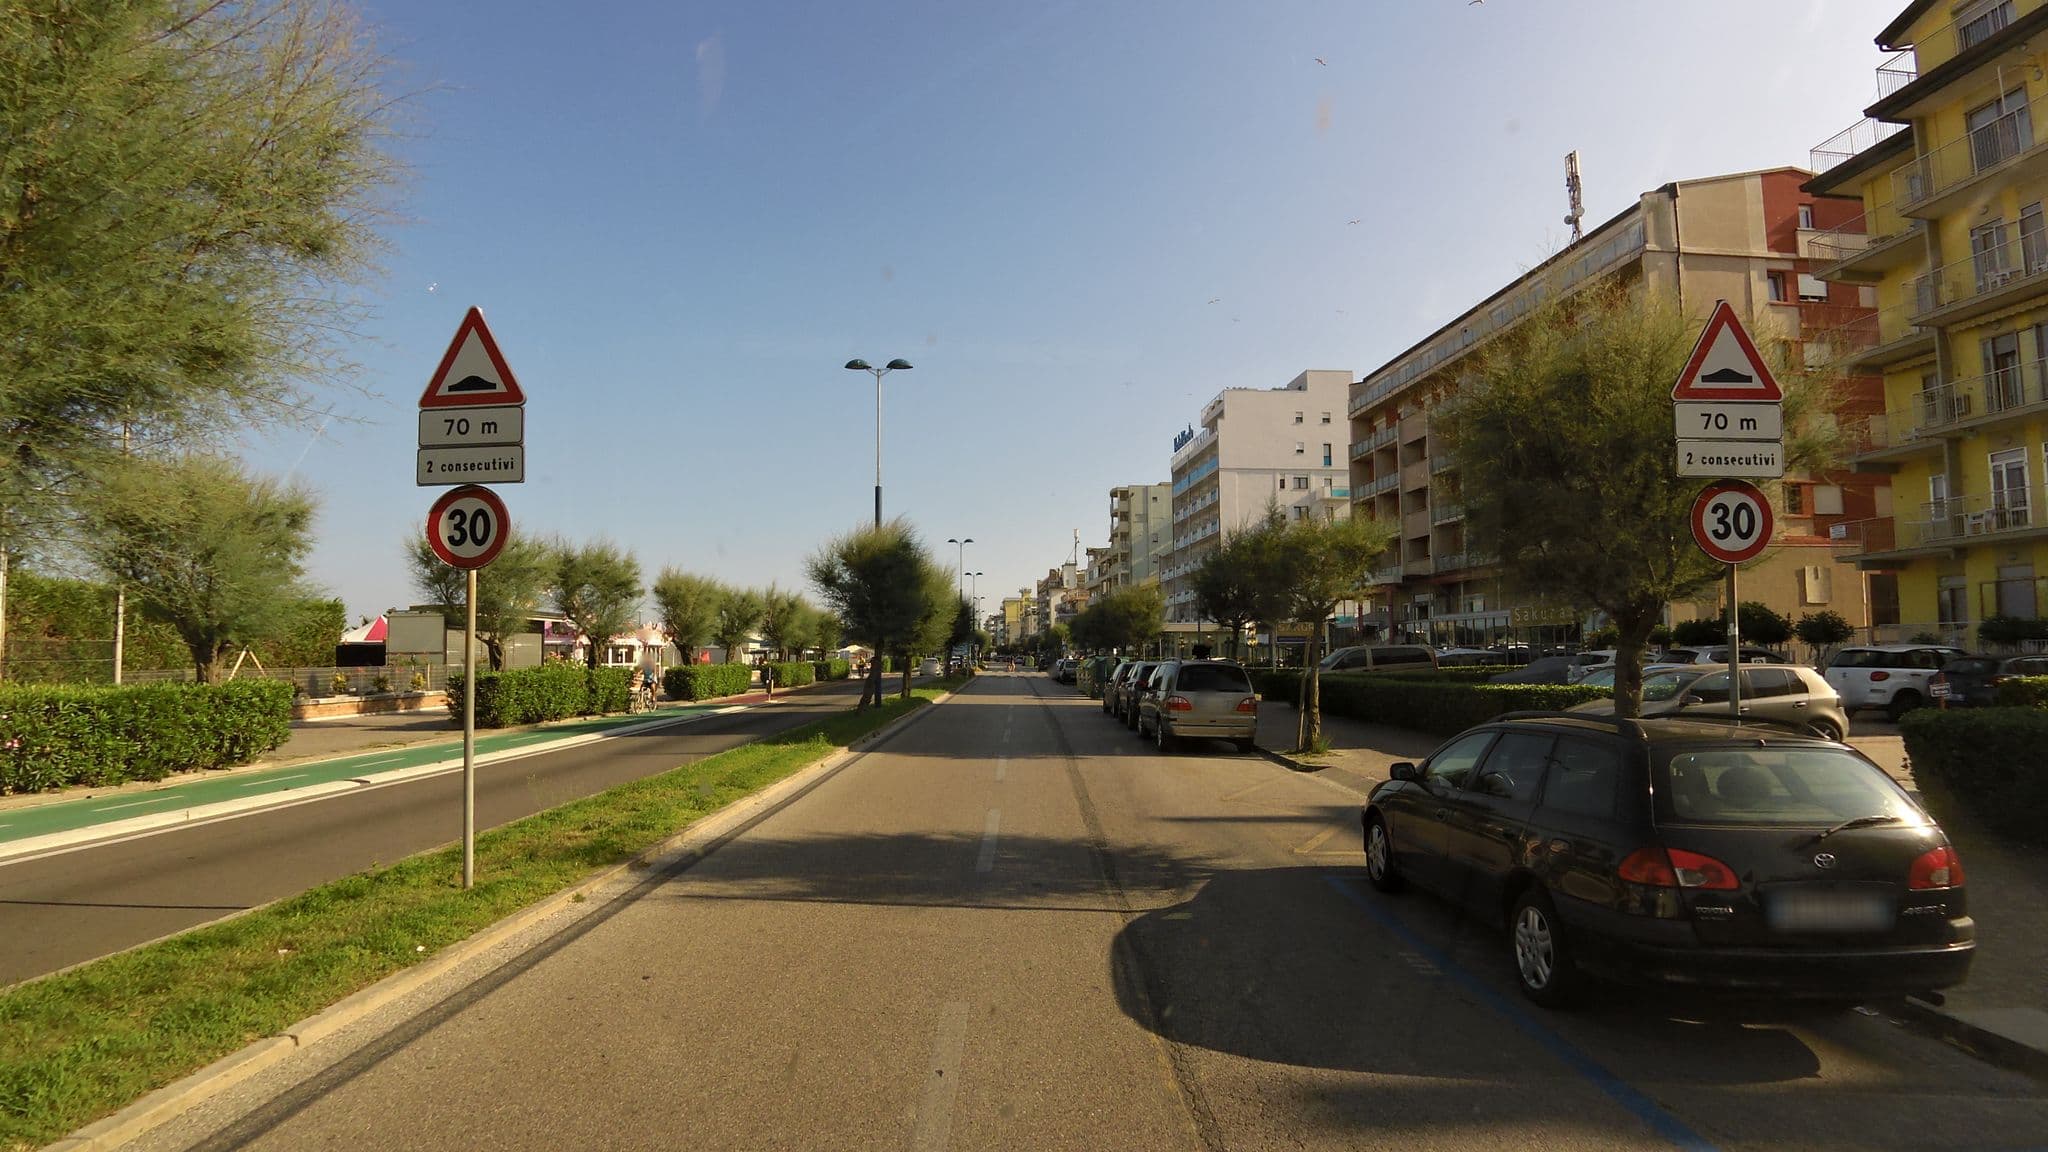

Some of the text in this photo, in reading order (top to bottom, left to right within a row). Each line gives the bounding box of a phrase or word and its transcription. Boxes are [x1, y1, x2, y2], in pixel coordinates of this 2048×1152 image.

[443, 417, 498, 436] 70 m
[1700, 412, 1757, 431] 70 m
[426, 457, 514, 474] 2 consecutivi
[1686, 451, 1775, 466] 2 consecutivi
[447, 508, 491, 547] 30
[1710, 502, 1756, 541] 30
